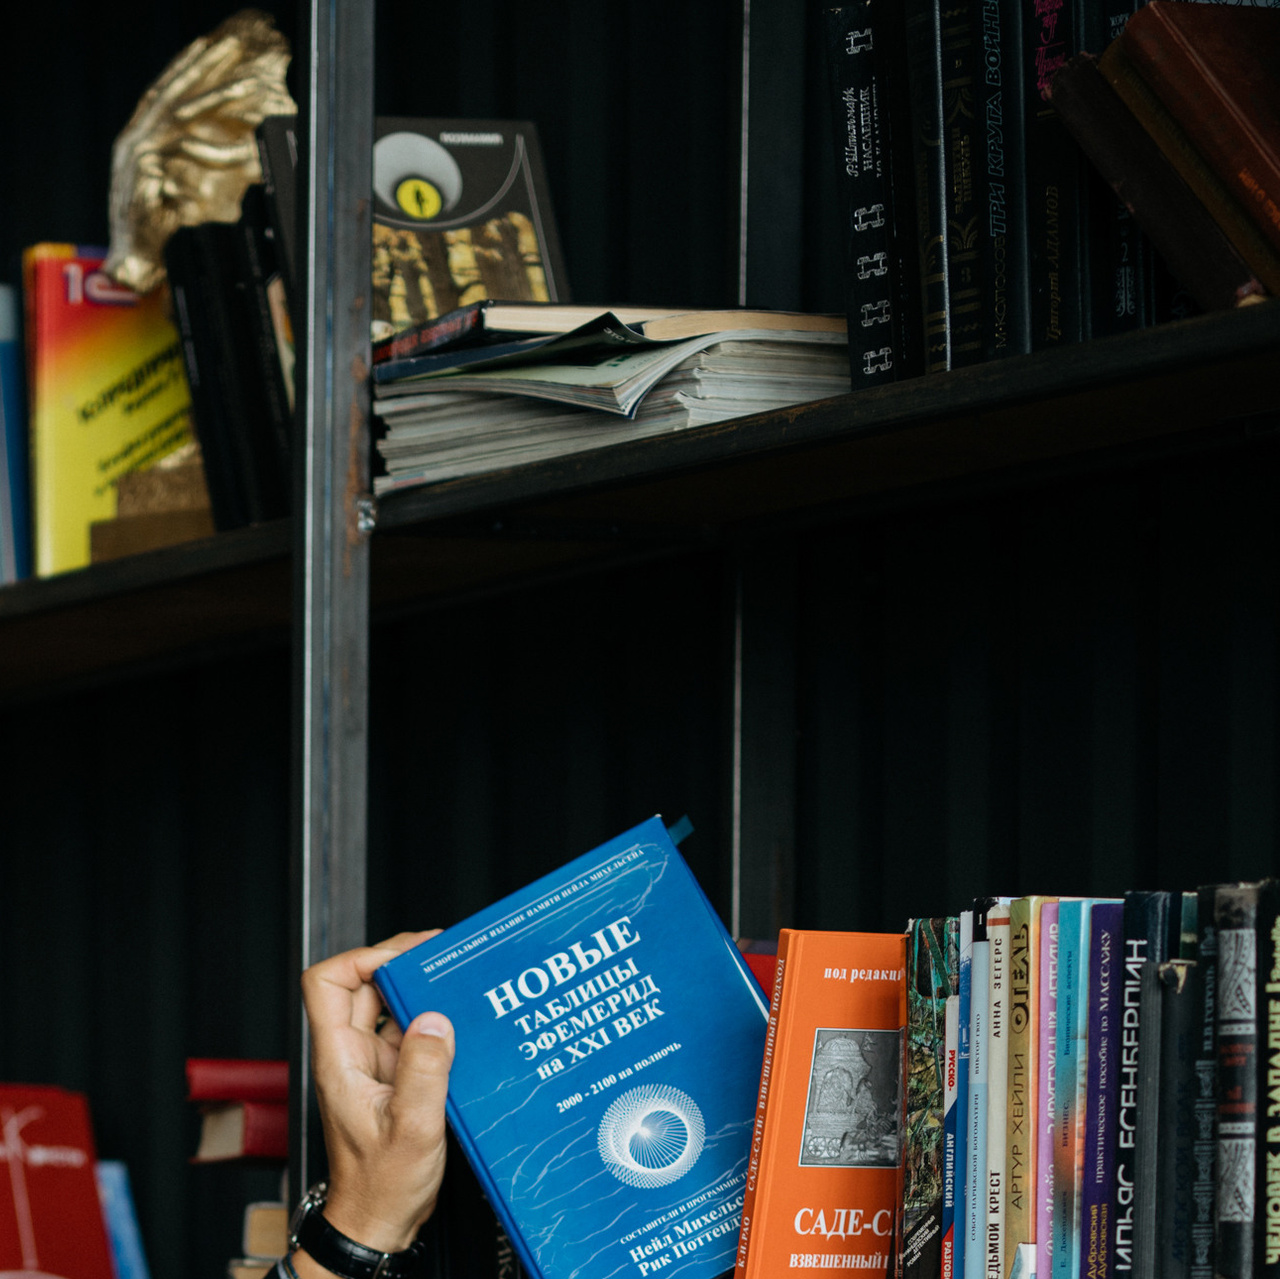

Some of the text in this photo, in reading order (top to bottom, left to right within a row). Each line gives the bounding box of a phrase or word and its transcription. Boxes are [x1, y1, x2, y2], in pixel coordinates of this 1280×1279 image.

[859, 85, 873, 171] НАСЛЕДНИК
[986, 91, 1005, 176] КРУГА
[989, 183, 1006, 236] ТРИ
[1045, 183, 1060, 267] АДАМОВ
[422, 932, 490, 975] МЕМОРИАЛЬНОЕ
[488, 911, 527, 939] ИЗДАНИЕ
[525, 892, 562, 918] ПАМЯТИ
[559, 876, 590, 899] НЕЙЛА
[993, 937, 1002, 989] ЗЕГЕРС
[482, 914, 644, 1020] НОВЫЕ
[513, 956, 642, 1039] ТАБЛИЦЫ
[824, 967, 846, 979] под
[515, 972, 662, 1064] ЭФЕМЕРИД
[534, 996, 666, 1081] на XXI ВЕК
[758, 1015, 778, 1109] ВЗВЕШЕННЫЙ
[770, 957, 786, 1011] ПОДХОД
[992, 1000, 1001, 1037] АННА
[1094, 928, 1112, 1183] практическое пособие по МАССАЖУ
[554, 1037, 683, 1114] 2000 2100 на полночь
[947, 1049, 955, 1091] РУССКО-
[1010, 922, 1031, 1209] АРТУР ХЕЙЛИ ОТЕЛЬ
[944, 1132, 954, 1207] АНГЛИЙСКИЙ
[988, 1169, 1001, 1213] КРЕСТ
[619, 1208, 680, 1245] СОСТАВИТЕЛИ
[678, 1204, 687, 1213] И
[628, 1230, 674, 1264] Нейл
[789, 1251, 881, 1269] ВЗВЕШЕННЫЙ
[905, 1250, 922, 1267] РОМАН
[637, 1249, 672, 1277] Рик
